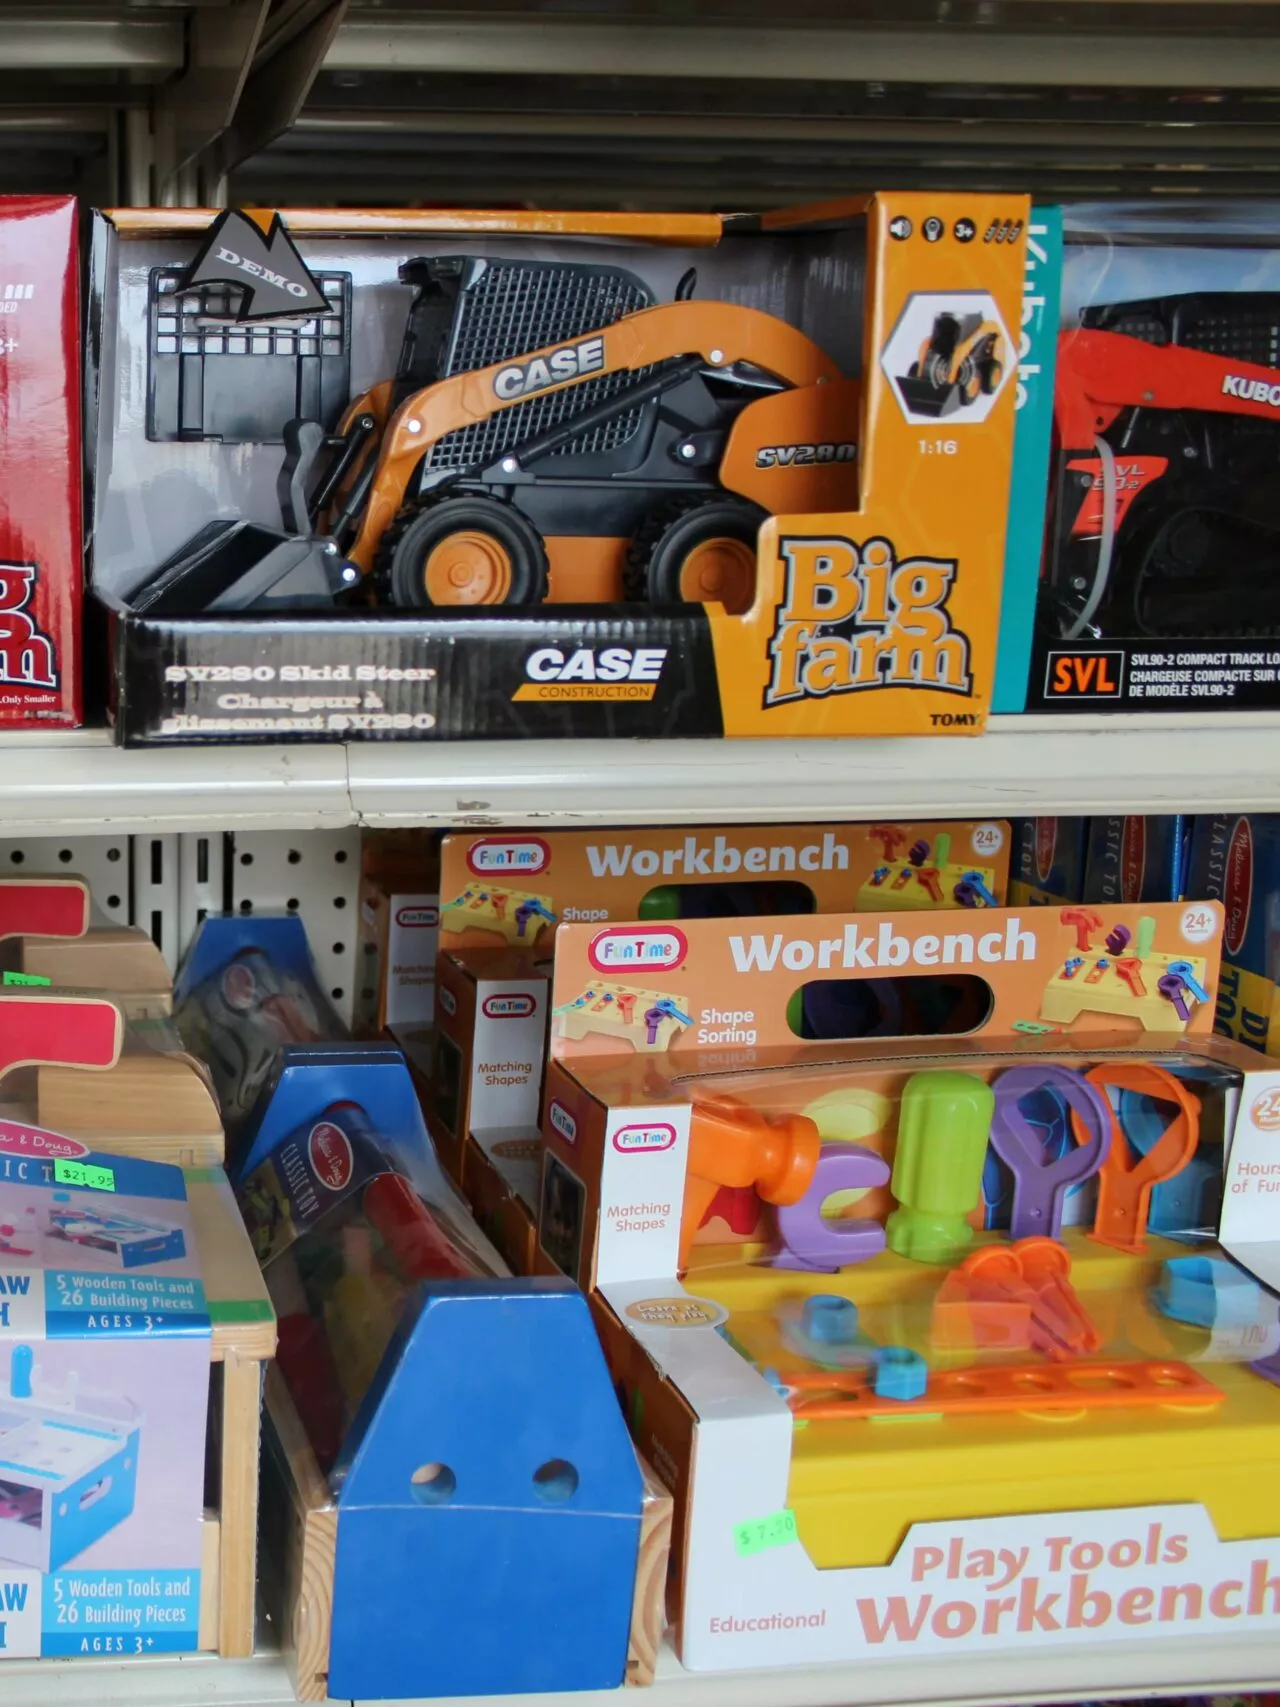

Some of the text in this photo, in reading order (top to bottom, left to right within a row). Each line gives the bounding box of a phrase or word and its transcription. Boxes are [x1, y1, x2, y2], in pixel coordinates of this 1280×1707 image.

[215, 247, 308, 297] DEMO
[494, 339, 602, 400] CASE
[755, 443, 857, 470] SV280
[918, 440, 958, 456] 1:16
[781, 540, 954, 642] Big
[526, 648, 668, 681] CASE
[766, 621, 970, 703] farm
[1131, 652, 1264, 666] SVL90-2 COMPACT TRACK
[165, 665, 437, 682] SV280 Skid Steer
[1053, 657, 1115, 693] SVL
[1130, 669, 1274, 683] CHARGEUSE COMPACTE SUR
[24, 694, 56, 704] Smaller
[538, 686, 650, 698] CONSTRUCTION
[1129, 683, 1235, 697] DE MODÈLE SVL90-2
[217, 693, 362, 712] Chargeur
[160, 714, 436, 733] glissement SV280
[930, 713, 979, 726] TOMY
[976, 830, 999, 845] 24+
[480, 849, 538, 865] Fun Time
[586, 833, 849, 877] Workbench
[563, 908, 608, 922] Shape
[1185, 913, 1212, 929] 24+
[604, 941, 673, 959] Fun Time
[729, 918, 1037, 972] Workbench
[490, 1001, 507, 1012] Fun
[700, 1008, 755, 1028] Shape
[698, 1028, 757, 1046] Sorting
[478, 1062, 532, 1075] Matching
[485, 1075, 528, 1087] Shapes
[20, 1134, 28, 1145] &
[33, 1136, 73, 1156] Doug
[622, 1132, 667, 1145] Fun Time
[62, 1168, 114, 1188] $21.95
[1231, 1179, 1248, 1194] of
[607, 1203, 671, 1218] Matching
[616, 1218, 666, 1234] Shapes
[56, 1274, 194, 1294] 5 Wooden Tools and
[61, 1288, 194, 1311] 26 Building Pieces
[87, 1314, 164, 1332] AGES 3+
[911, 1522, 1189, 1592] Play Tools
[54, 1575, 191, 1602] 5 Wooden Tools and
[855, 1559, 1280, 1645] Workbench
[57, 1600, 186, 1628] 26 Building Pieces
[710, 1609, 826, 1634] Educational
[80, 1636, 154, 1654] AGES 3+
